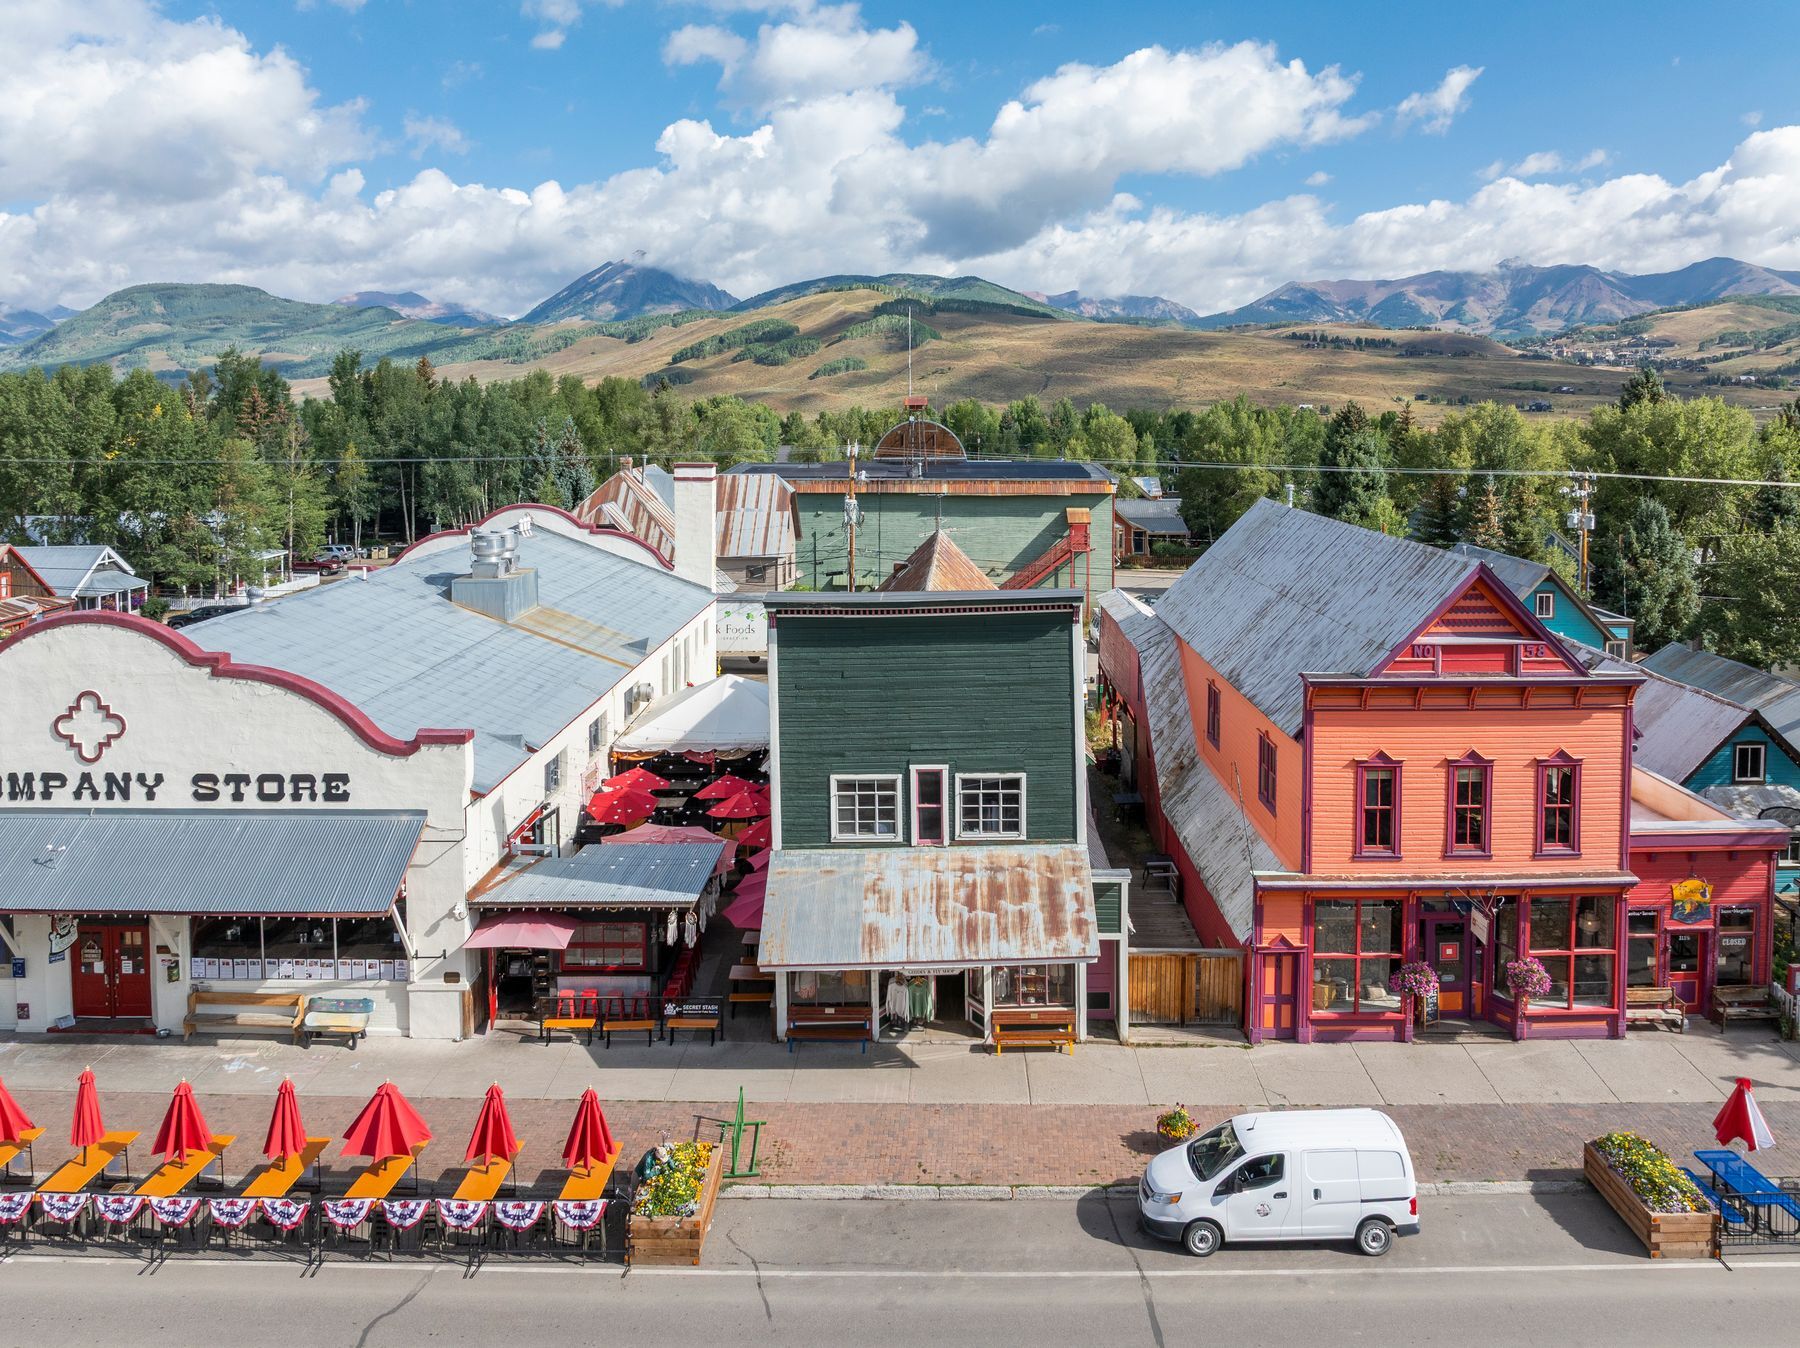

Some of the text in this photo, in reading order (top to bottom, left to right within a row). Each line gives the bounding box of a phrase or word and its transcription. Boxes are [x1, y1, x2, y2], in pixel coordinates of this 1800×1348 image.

[726, 624, 755, 634] Foods
[1413, 644, 1545, 658] NO 58
[0, 771, 351, 802] MPANY STORE
[1722, 938, 1747, 946] CLOSED
